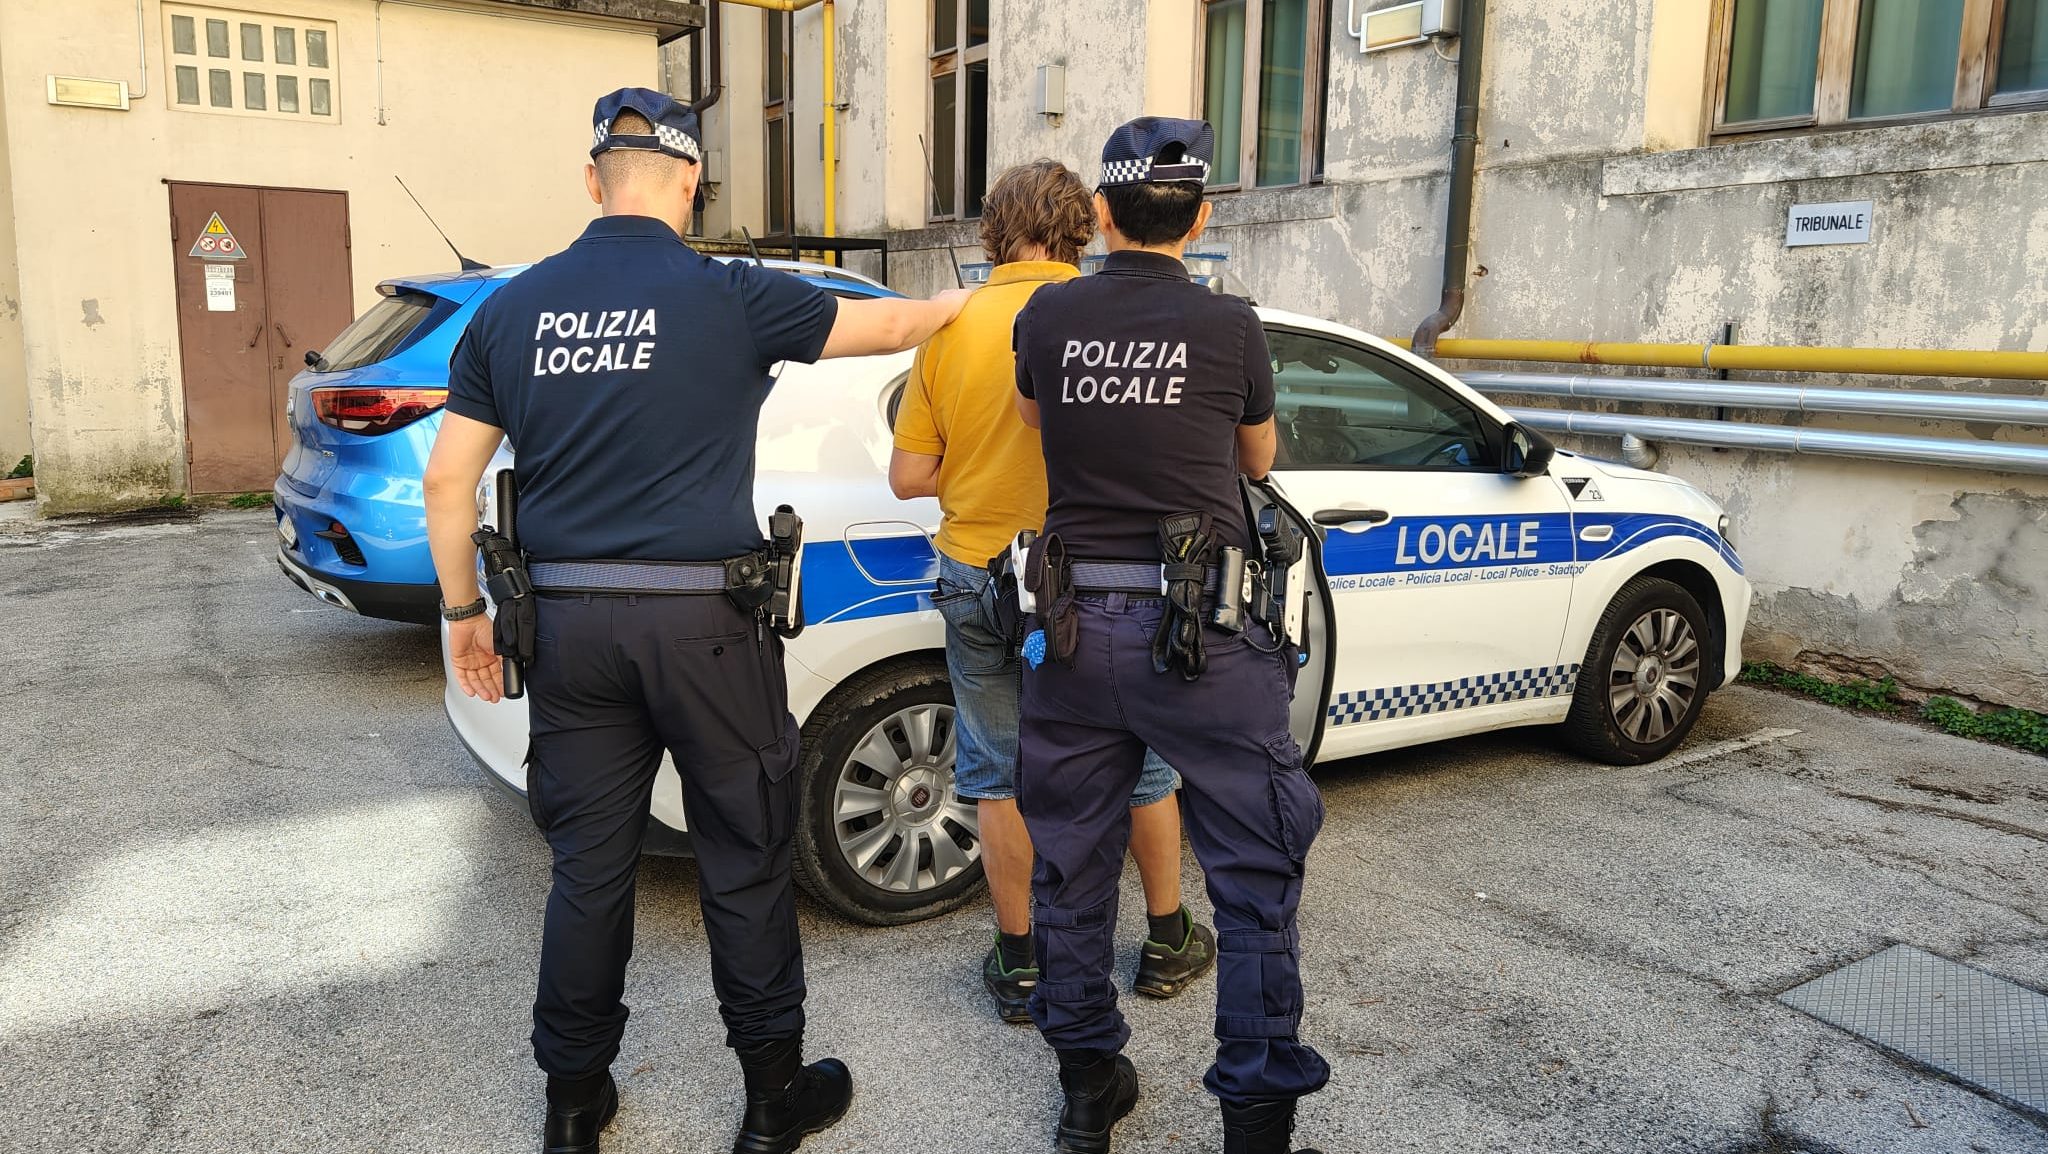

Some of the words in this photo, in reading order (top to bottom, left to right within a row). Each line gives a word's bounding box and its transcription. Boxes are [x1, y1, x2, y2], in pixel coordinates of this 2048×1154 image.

[1794, 213, 1865, 233] TRIBUNALE
[534, 308, 657, 341] POLIZIA
[533, 341, 656, 377] LOCALE
[1061, 340, 1188, 369] POLIZIA
[1061, 376, 1186, 405] LOCALE
[1588, 489, 1602, 500] 23
[1395, 521, 1540, 565] LOCALE
[1327, 577, 1356, 590] olice
[1358, 576, 1396, 588] Locale
[1444, 570, 1472, 583] Local
[1480, 569, 1508, 580] Local
[1509, 567, 1540, 578] Police
